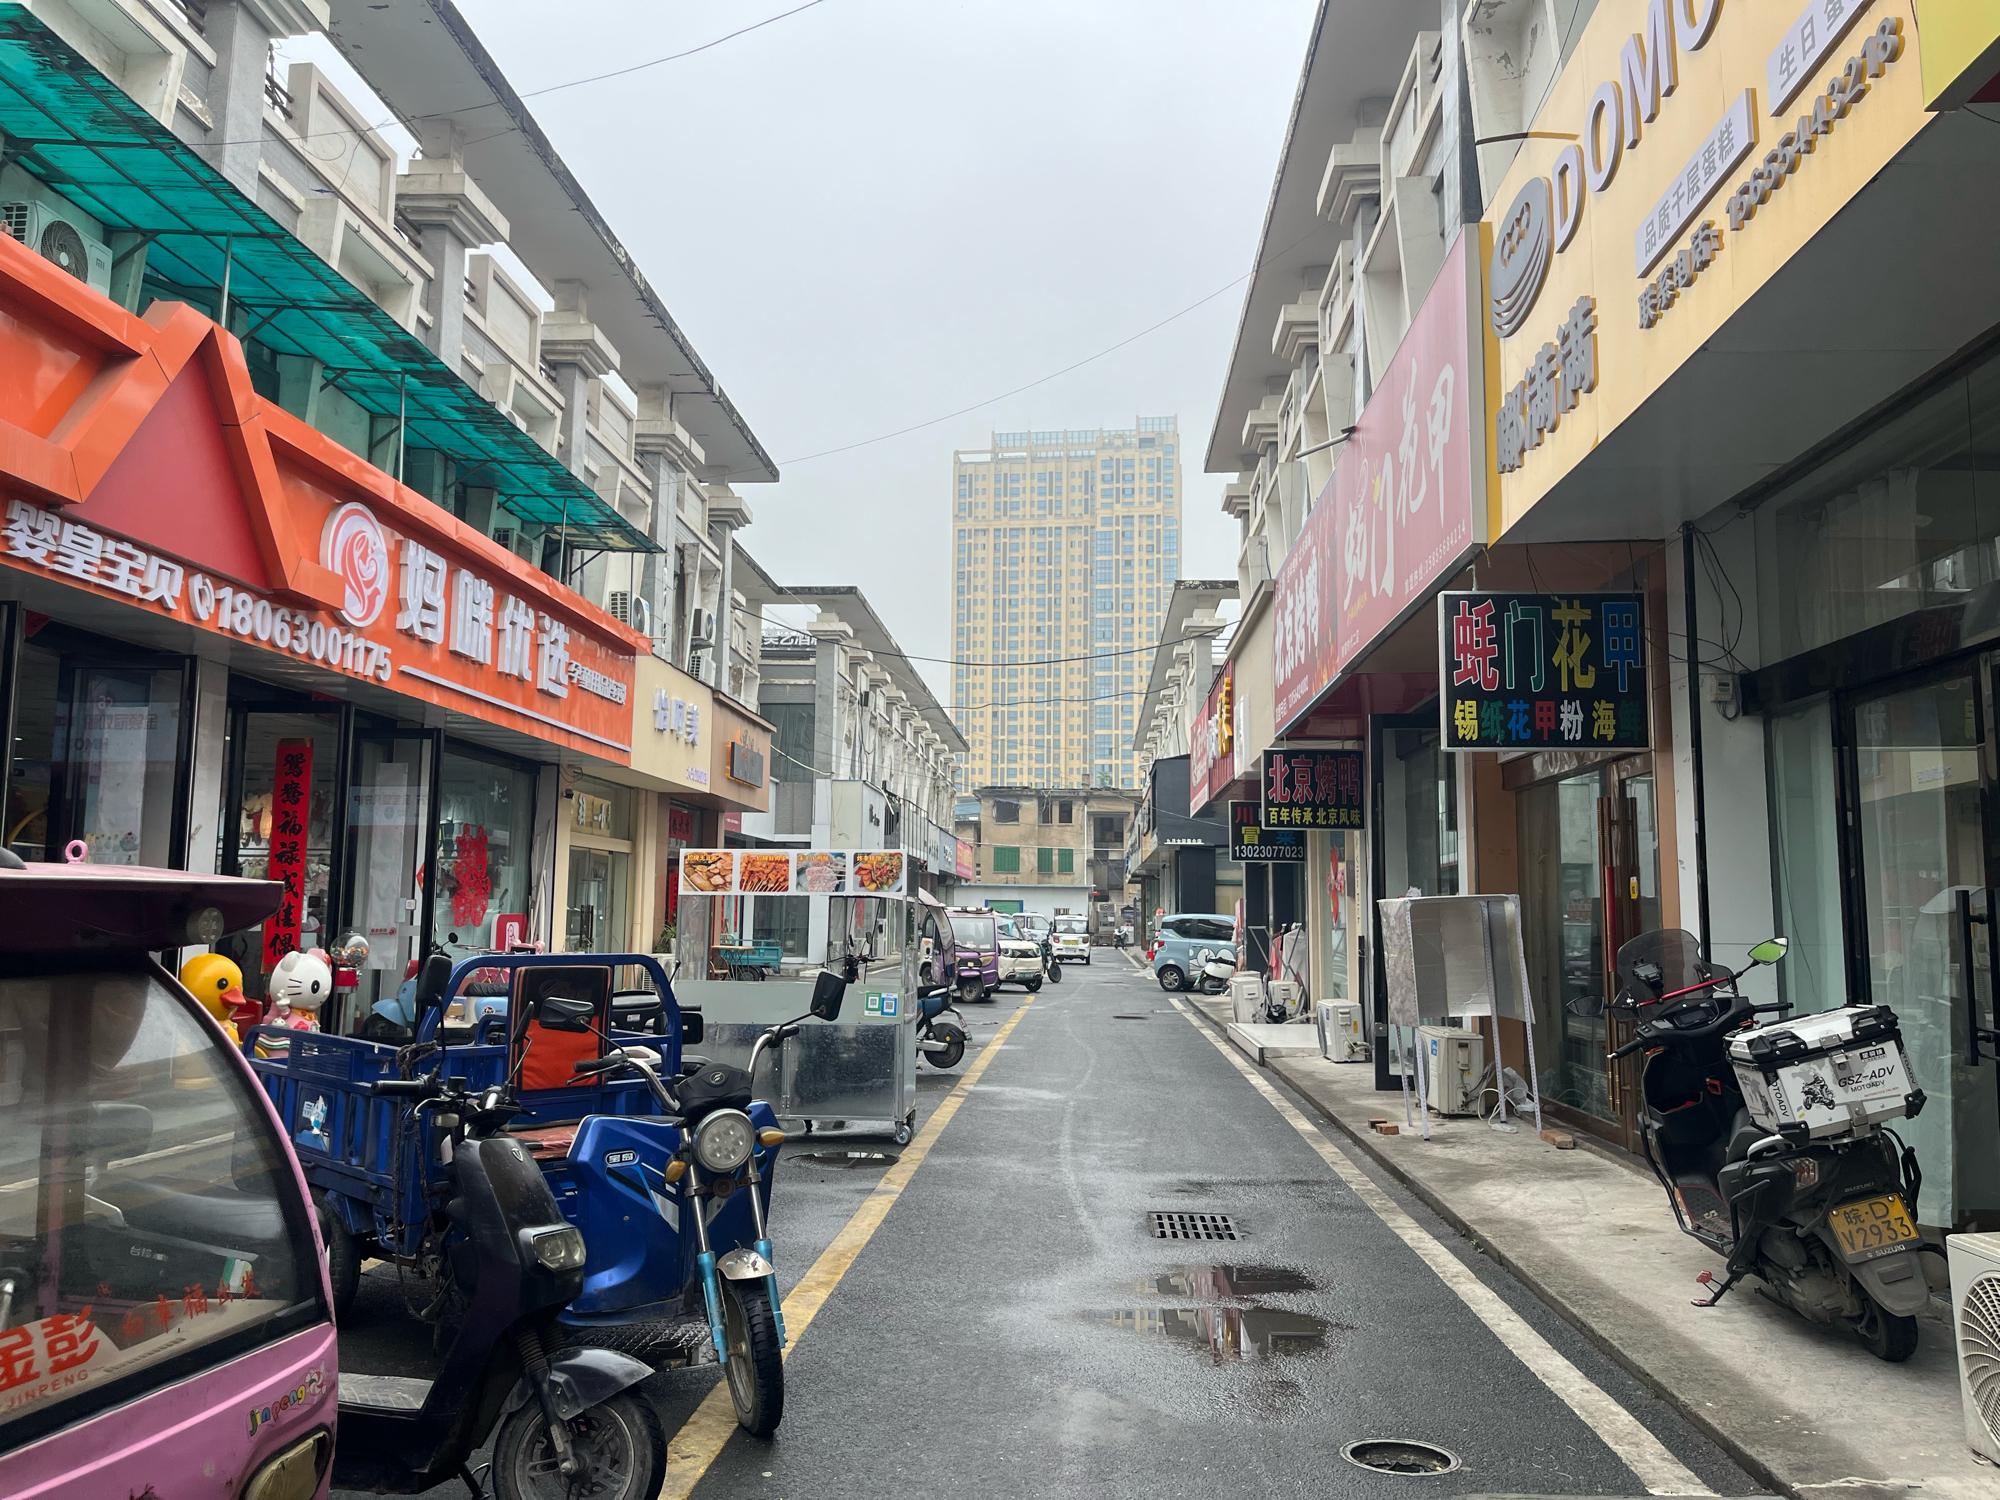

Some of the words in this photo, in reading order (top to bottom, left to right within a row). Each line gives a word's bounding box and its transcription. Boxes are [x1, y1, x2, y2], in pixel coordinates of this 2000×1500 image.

[1726, 17, 1905, 231] 15655443218
[1644, 117, 1735, 258] 品质千层蛋糕
[1638, 220, 1724, 329] 联系电话
[1496, 296, 1598, 475] 嘟满满
[1, 499, 184, 611] 婴皇宝贝
[214, 586, 393, 682] 18063001175
[396, 537, 572, 699] 妈咪优选
[1453, 598, 1641, 693] 蚝门花甲
[1453, 700, 1584, 741] 锡纸花甲粉
[1268, 753, 1360, 805] 北京烤鸭
[1268, 807, 1313, 825] 百年传承
[1316, 808, 1360, 825] 北京风味
[1234, 846, 1304, 858] 13023077023
[1838, 1065, 1895, 1088] GSZ-ADV
[1850, 1080, 1885, 1093] MOTOADV
[1844, 1182, 1874, 1193] SUZUKI
[1841, 1217, 1912, 1250] V2933
[1875, 1244, 1906, 1257] SUZUKI
[0, 1305, 100, 1392] 金彭
[7, 1370, 89, 1409] JINPENG
[249, 1384, 306, 1436] Jinpeng
